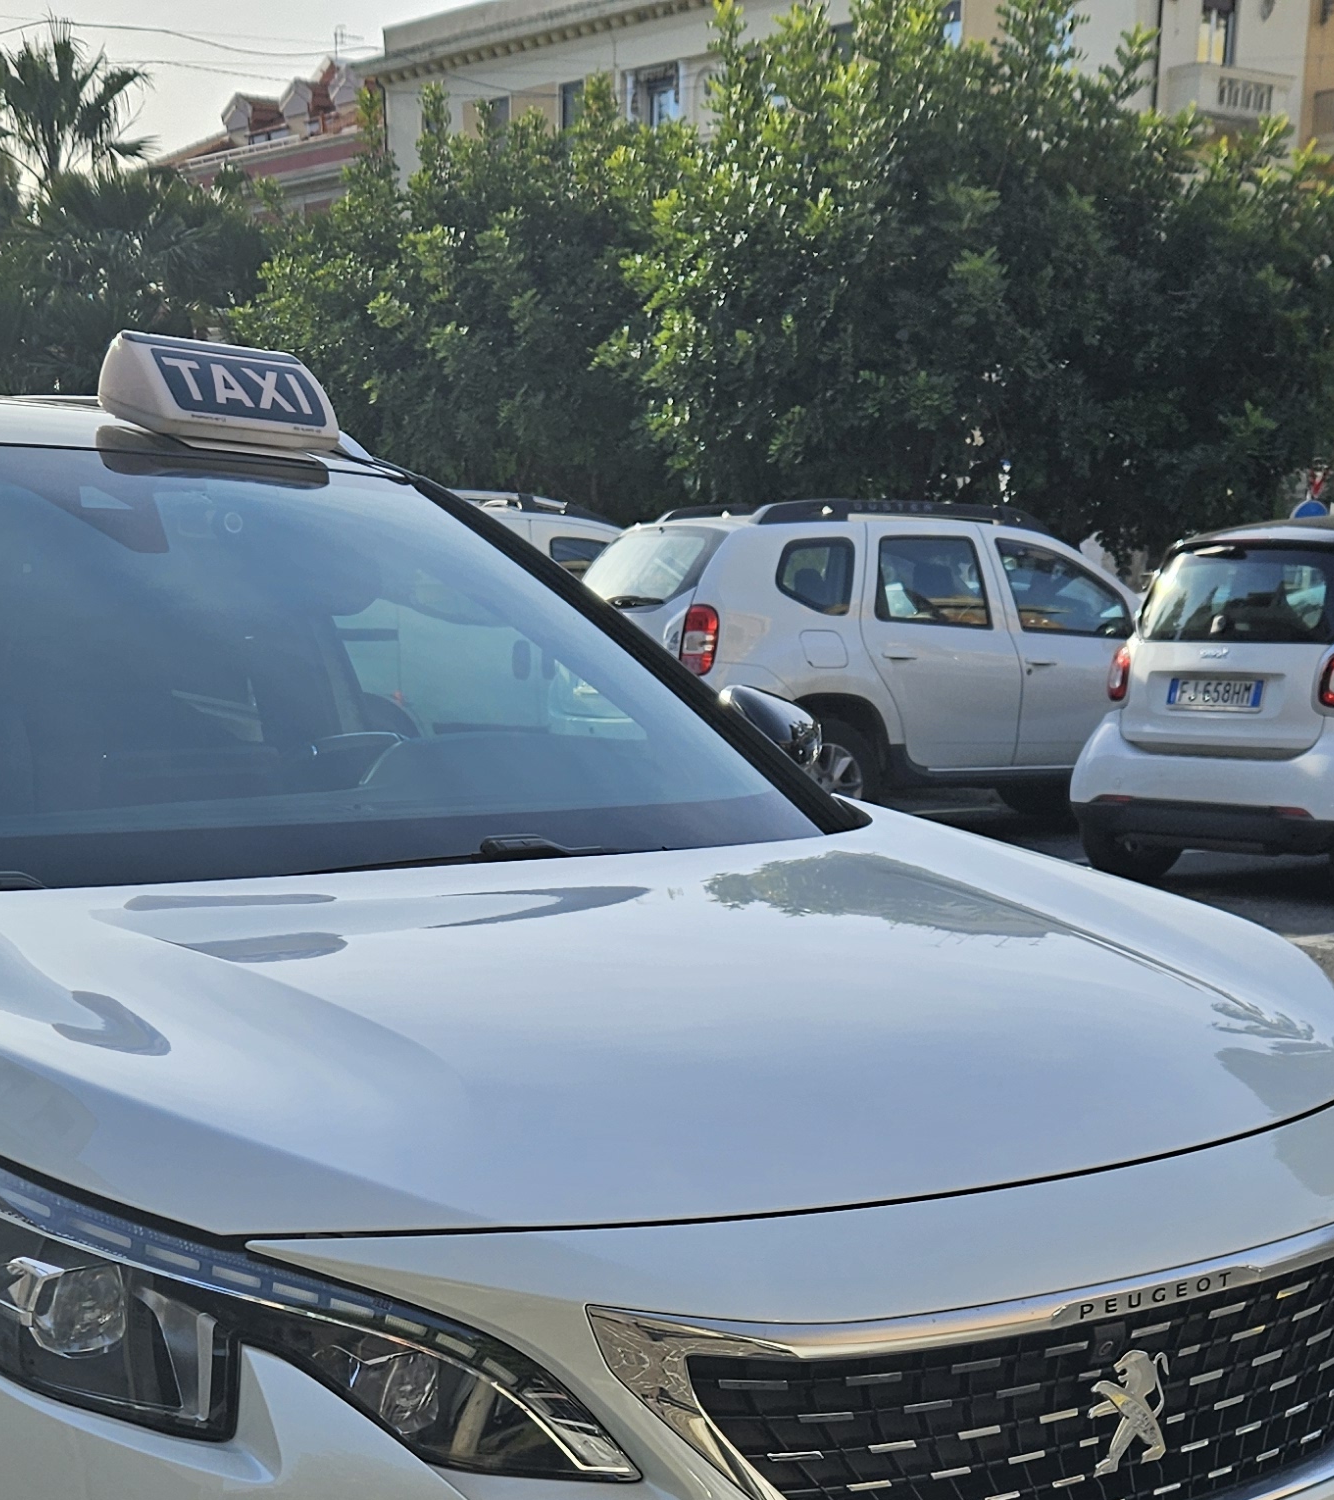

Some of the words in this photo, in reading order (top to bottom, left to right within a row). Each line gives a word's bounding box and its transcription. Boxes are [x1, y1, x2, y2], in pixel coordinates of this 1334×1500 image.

[160, 356, 313, 415] TAXI
[1178, 681, 1199, 702] FJ
[1079, 1271, 1233, 1320] PEUGEOT
